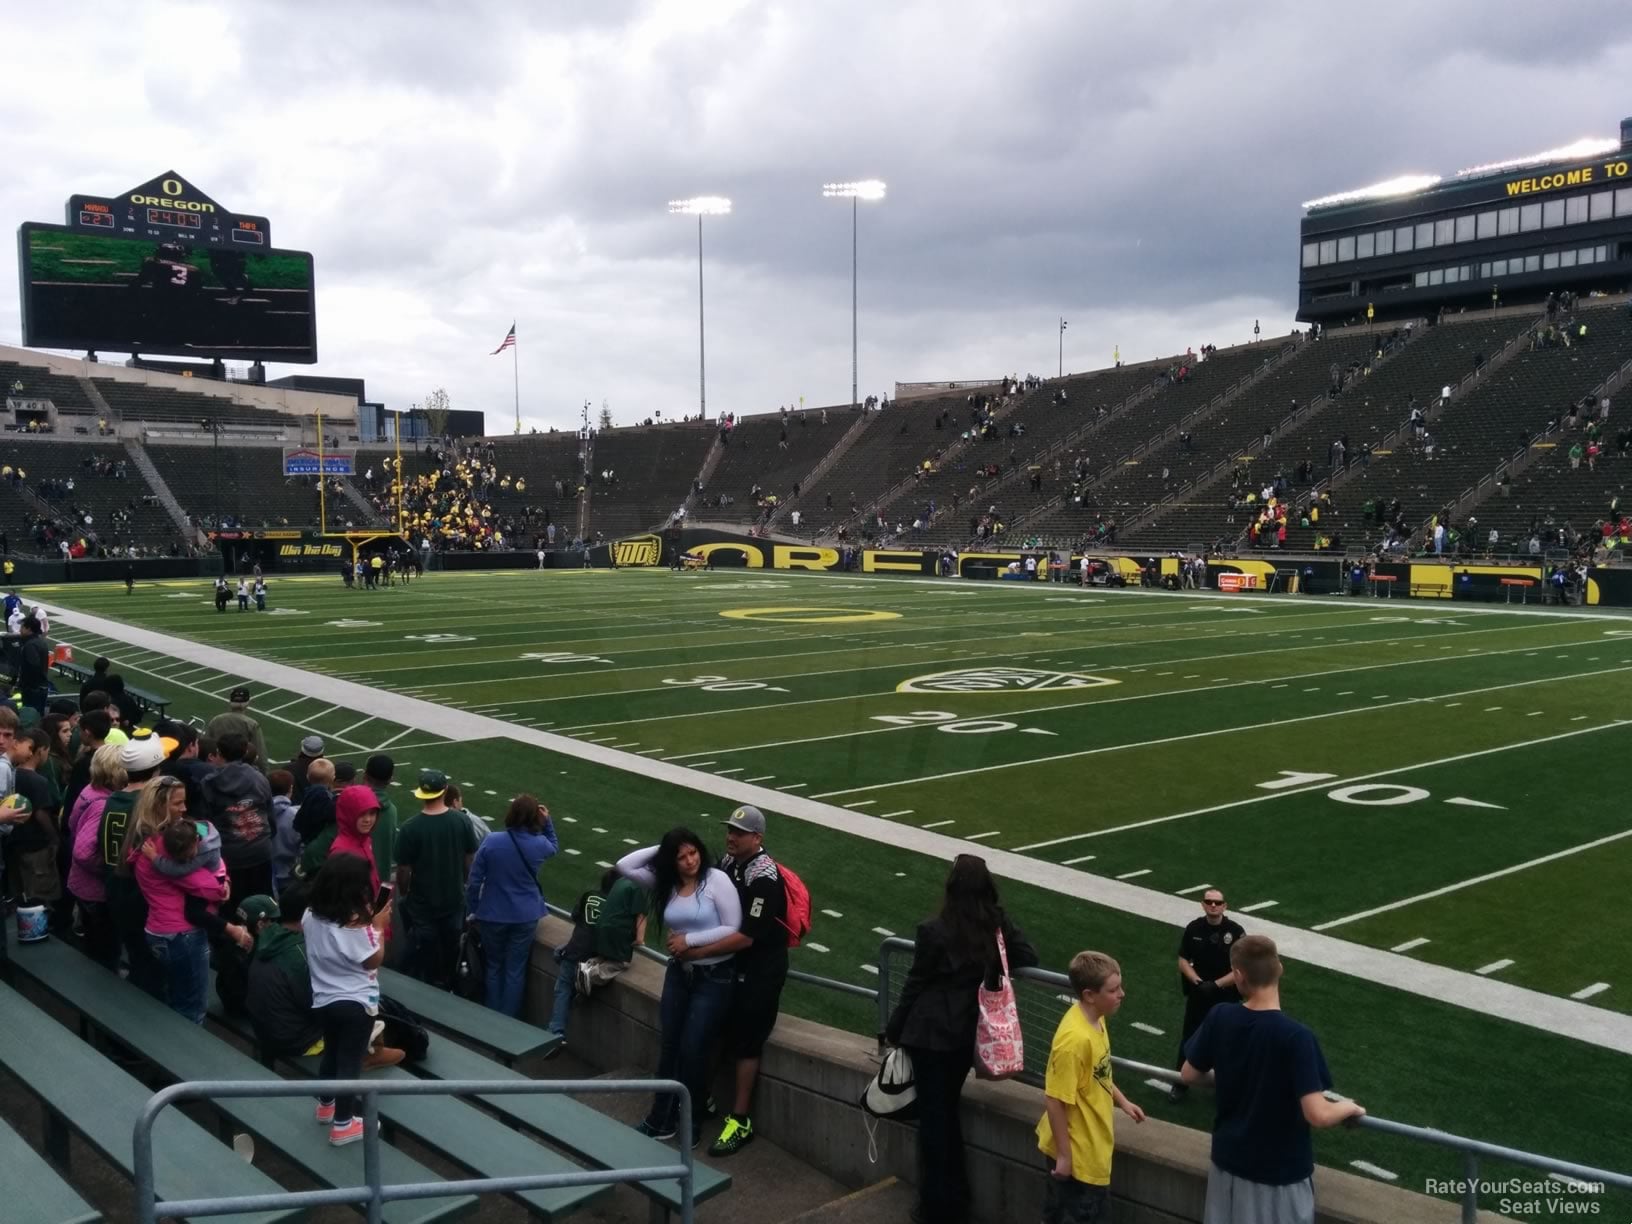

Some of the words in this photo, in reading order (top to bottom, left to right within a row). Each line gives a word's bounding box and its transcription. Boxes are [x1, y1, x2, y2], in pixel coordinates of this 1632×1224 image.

[162, 179, 183, 196] O
[1507, 168, 1592, 195] WELCOME
[1604, 162, 1629, 178] TO
[131, 194, 214, 213] OREGON
[170, 265, 188, 286] 3
[661, 675, 769, 692] 30
[869, 711, 1018, 734] 20
[1255, 770, 1431, 806] 10
[750, 897, 765, 918] 6
